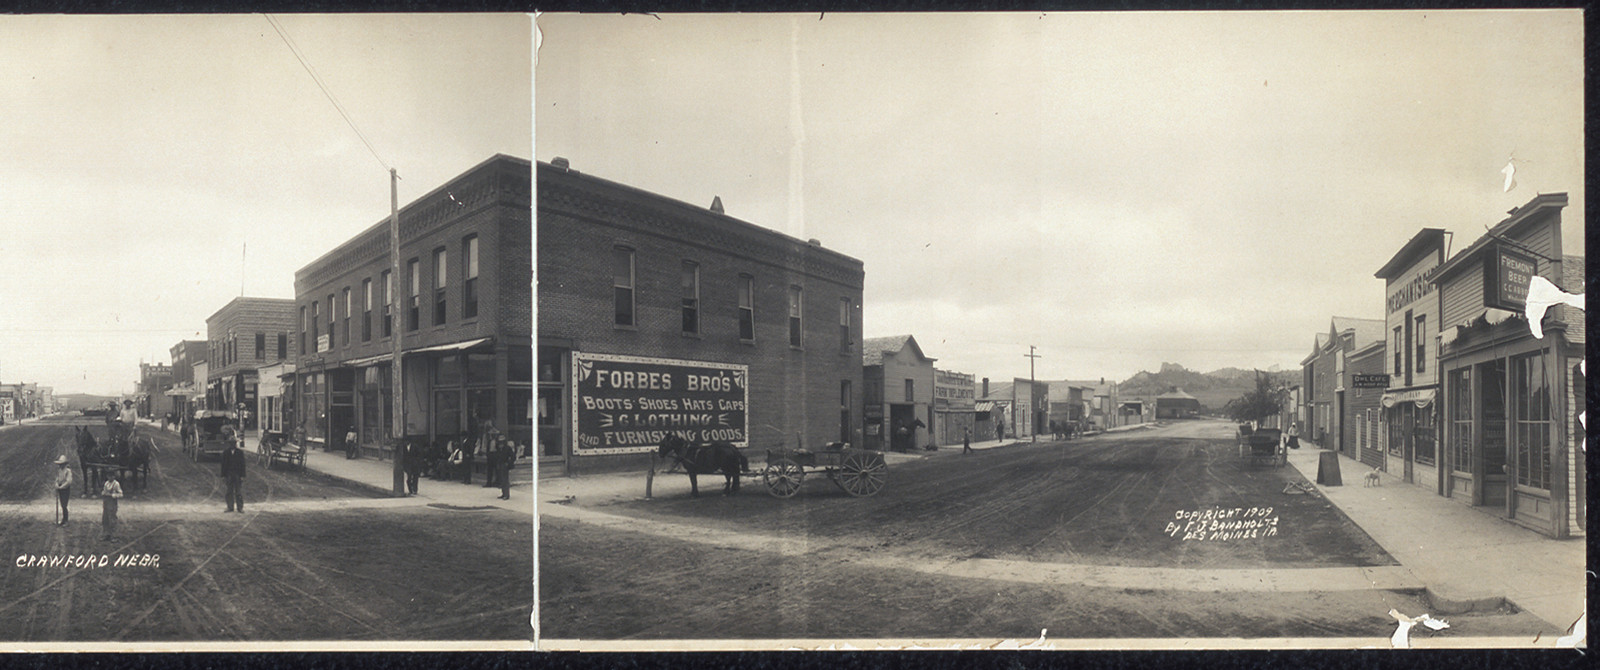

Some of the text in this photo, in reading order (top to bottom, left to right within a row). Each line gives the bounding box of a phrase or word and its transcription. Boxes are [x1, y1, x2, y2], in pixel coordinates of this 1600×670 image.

[1508, 270, 1527, 285] BEER
[595, 369, 731, 392] FORBES BRO'S
[582, 396, 745, 411] BOOTS SHOES HATS CAPS
[618, 414, 713, 427] CLOTHING
